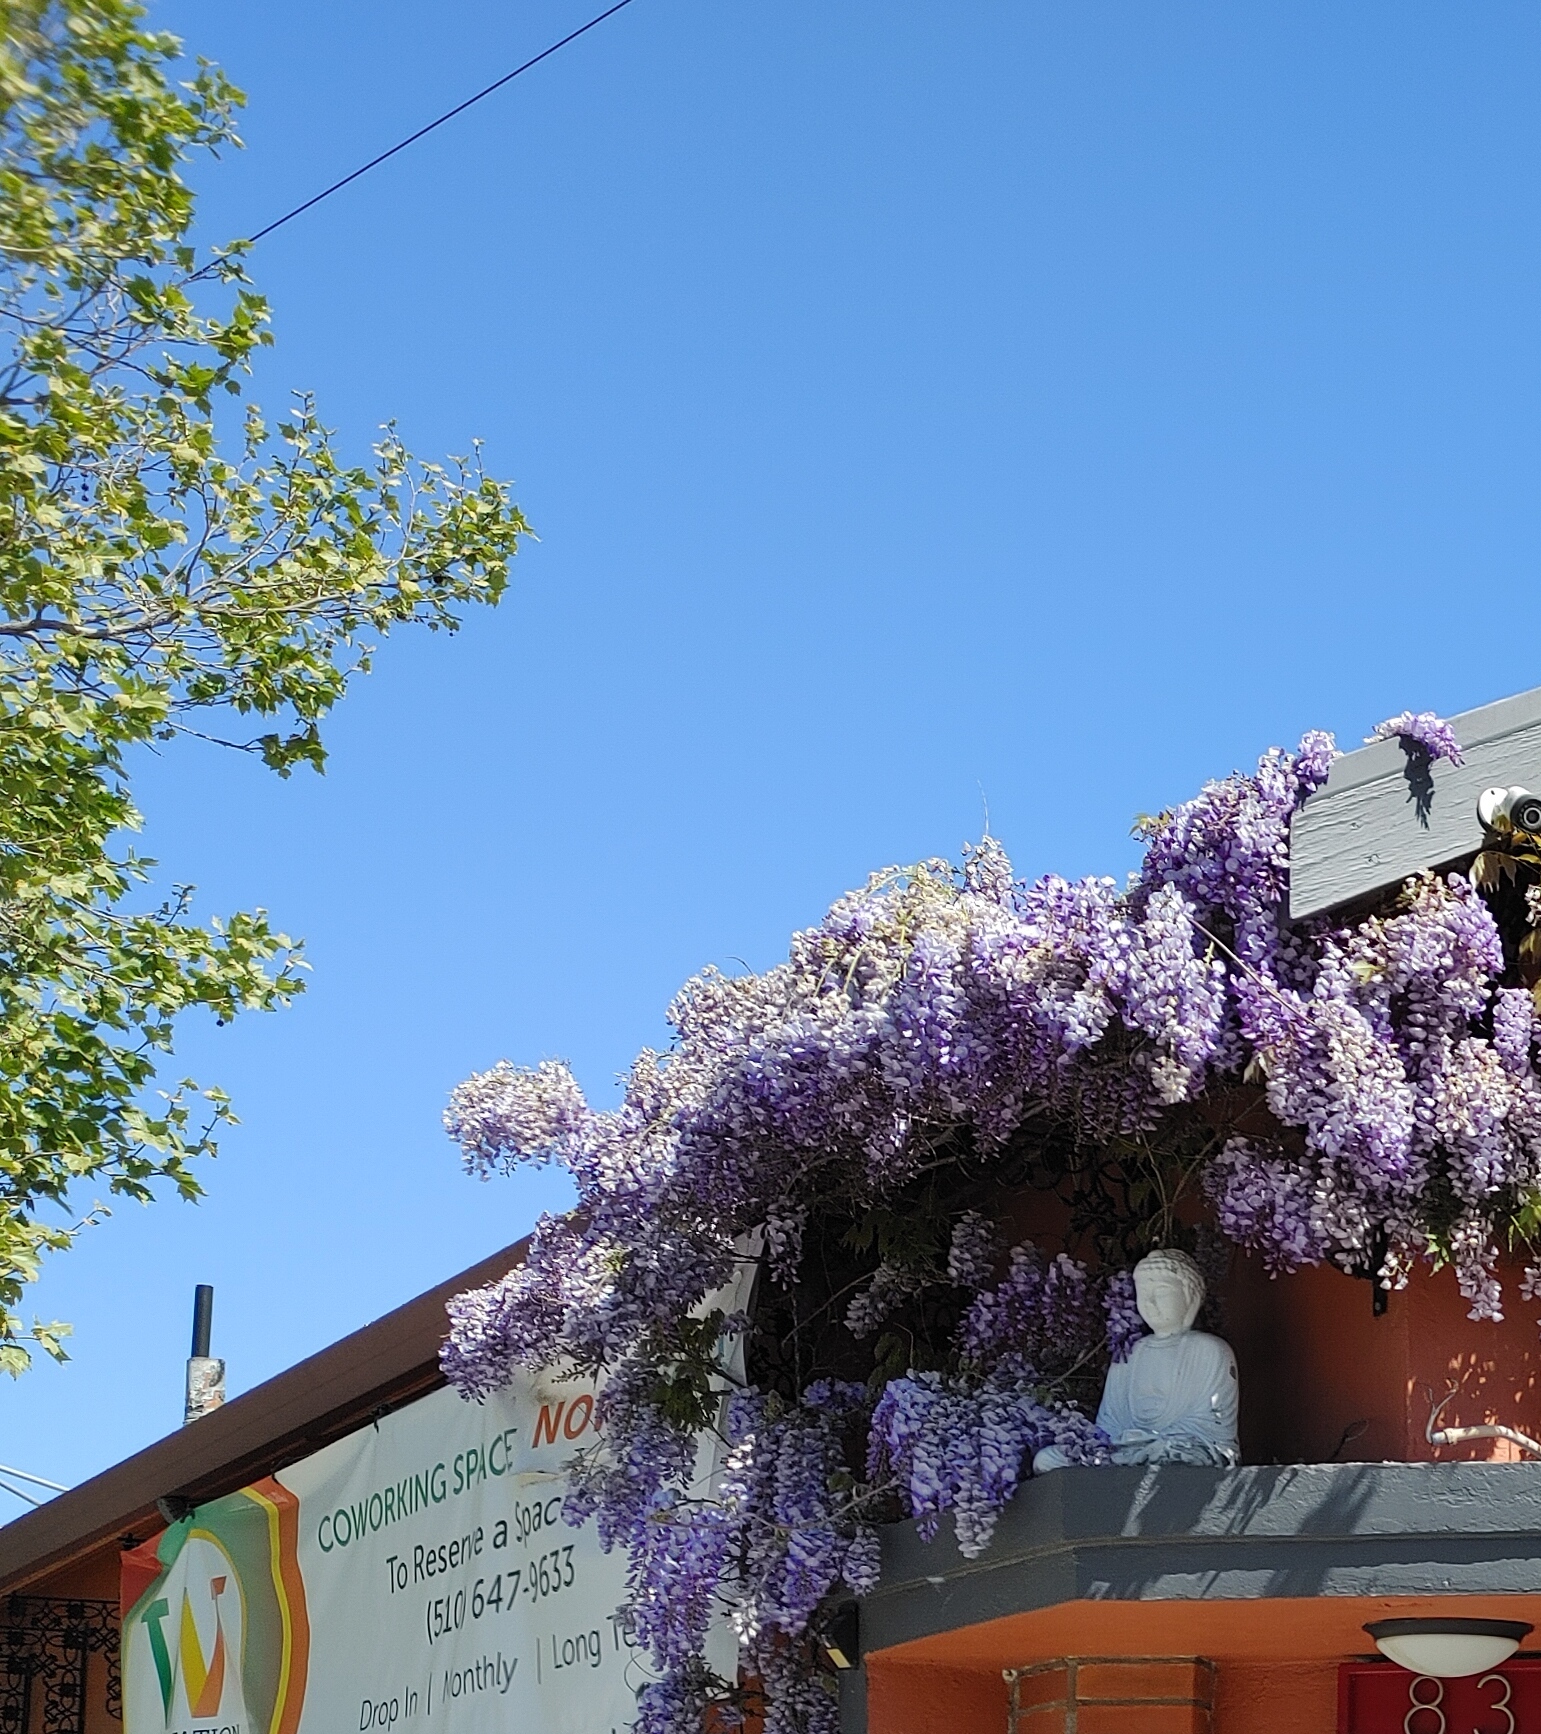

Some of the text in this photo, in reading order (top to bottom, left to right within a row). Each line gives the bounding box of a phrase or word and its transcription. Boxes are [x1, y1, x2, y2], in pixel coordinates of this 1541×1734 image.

[532, 1394, 605, 1449] NO
[318, 1428, 518, 1552] COWORKING SPACE
[386, 1496, 562, 1594] To Reserve a Spac
[427, 1544, 575, 1645] (510) 647-9633
[359, 1698, 398, 1732] Drop
[405, 1686, 418, 1719] In
[552, 1629, 602, 1669] Long
